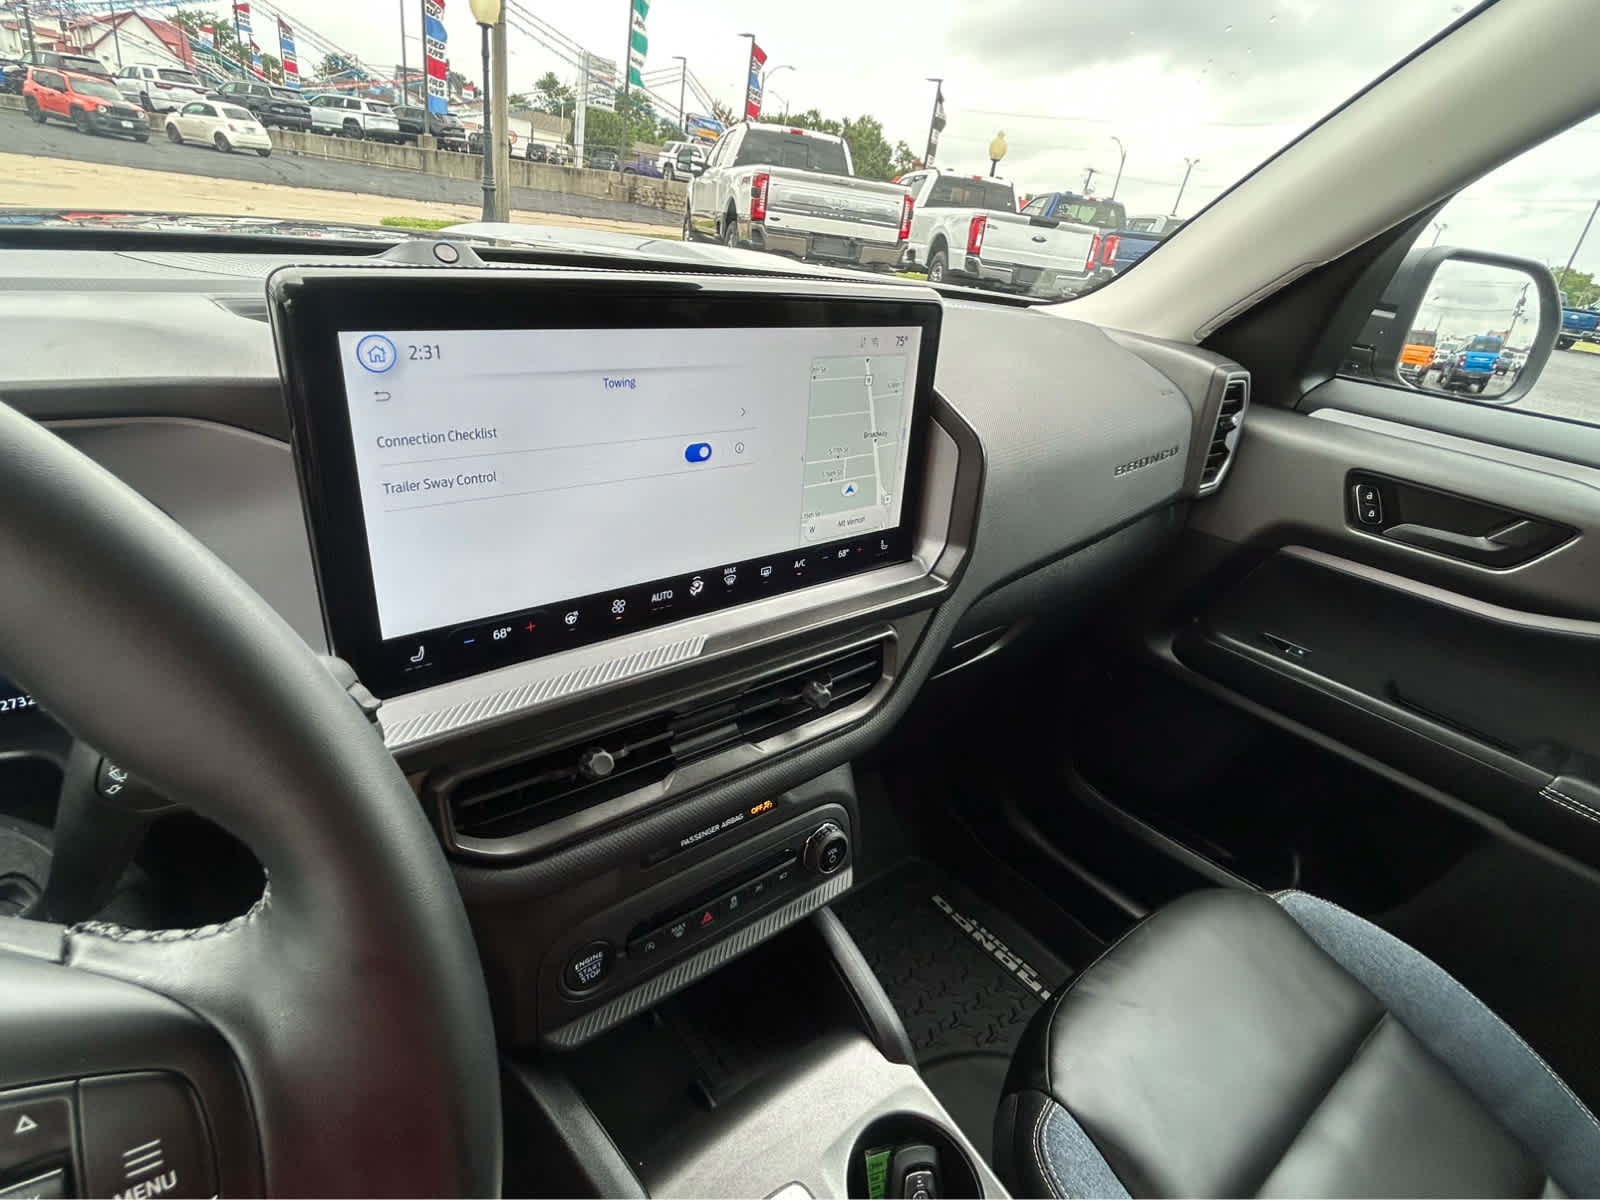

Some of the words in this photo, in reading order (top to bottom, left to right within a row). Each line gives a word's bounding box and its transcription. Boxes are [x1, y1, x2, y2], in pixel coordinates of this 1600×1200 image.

[895, 336, 909, 347] 75°
[408, 344, 442, 361] 2:31
[603, 376, 637, 390] Towing
[376, 431, 446, 449] Connection
[447, 426, 498, 443] Checklist
[1113, 446, 1180, 476] BRONCO
[383, 480, 421, 496] Trailer
[423, 477, 455, 493] Sway
[456, 471, 498, 487] Control
[837, 549, 850, 558] 68°
[723, 567, 737, 575] MAX
[793, 559, 806, 569] A/C
[651, 590, 673, 603] AUTO
[493, 627, 512, 640] 68°
[750, 805, 764, 815] OFF
[680, 824, 721, 847] PASSENGER
[721, 813, 744, 829] AIRBAG
[575, 951, 603, 970] ENGINE
[578, 961, 601, 978] START
[580, 968, 601, 984] STOP
